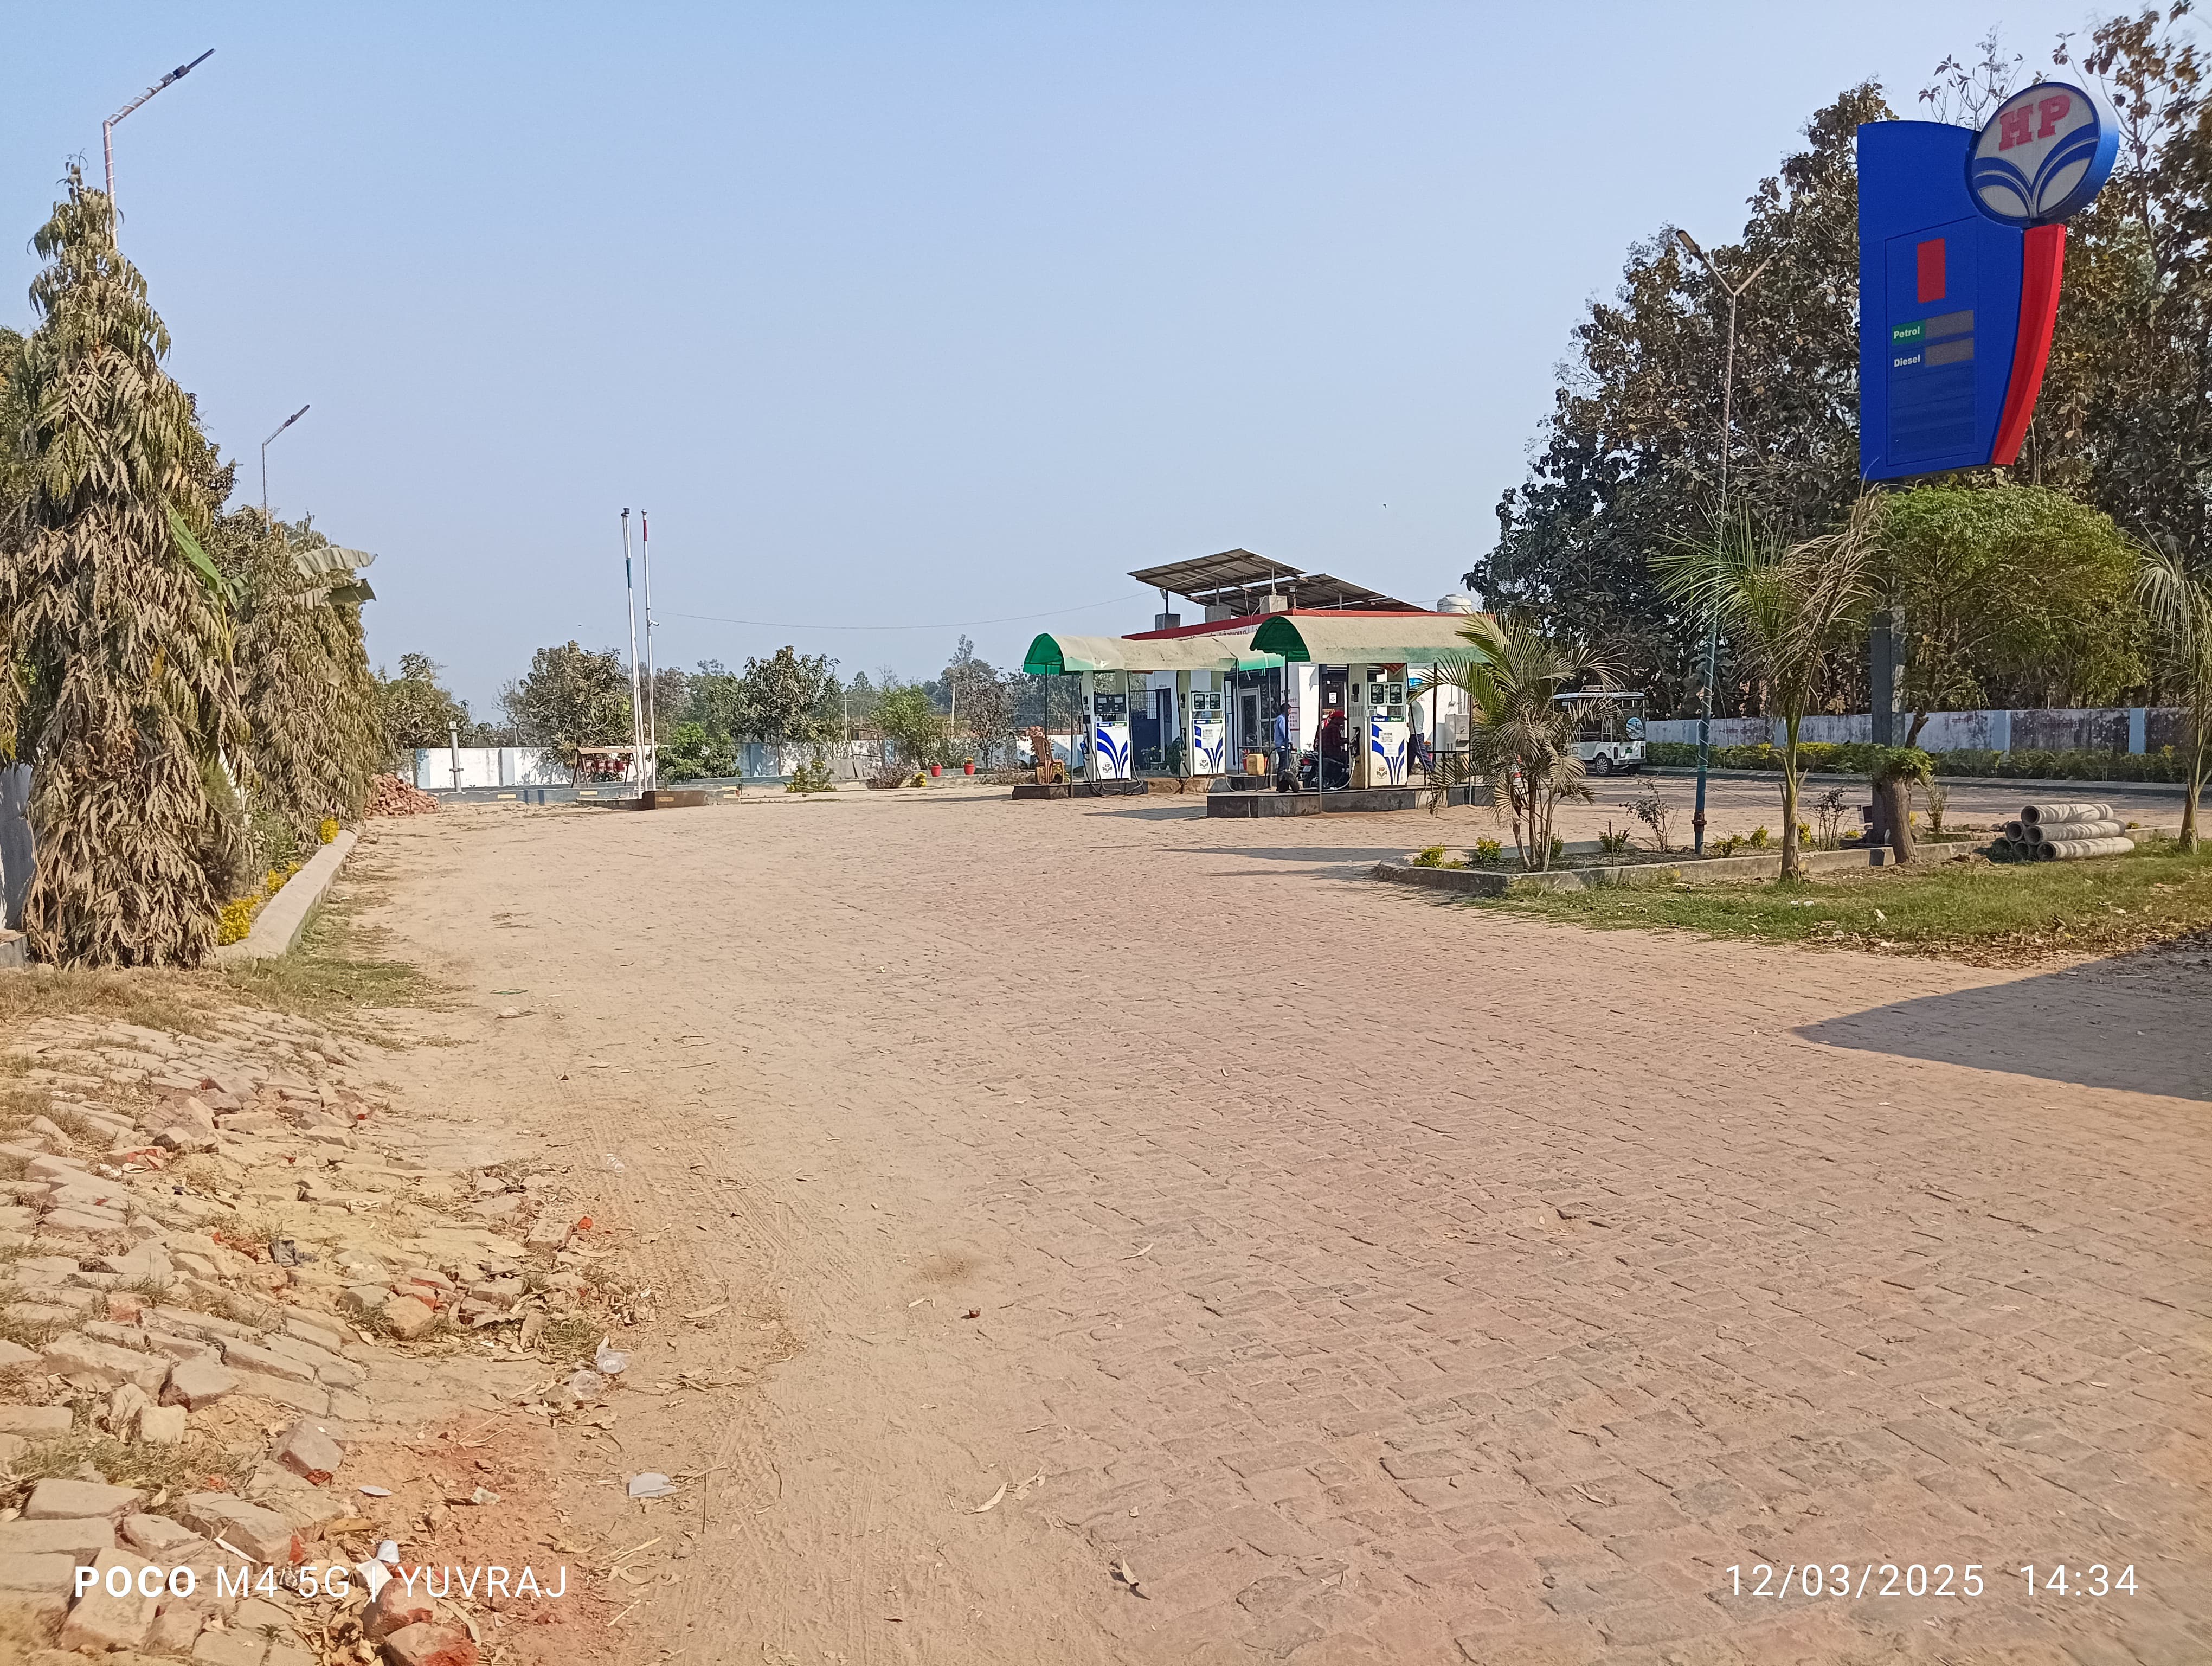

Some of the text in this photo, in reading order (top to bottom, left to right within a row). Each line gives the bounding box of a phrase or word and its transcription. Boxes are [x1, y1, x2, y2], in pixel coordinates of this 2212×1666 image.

[1998, 94, 2071, 152] HP
[1893, 326, 1921, 339] Petrol
[1894, 354, 1921, 368] Diesel
